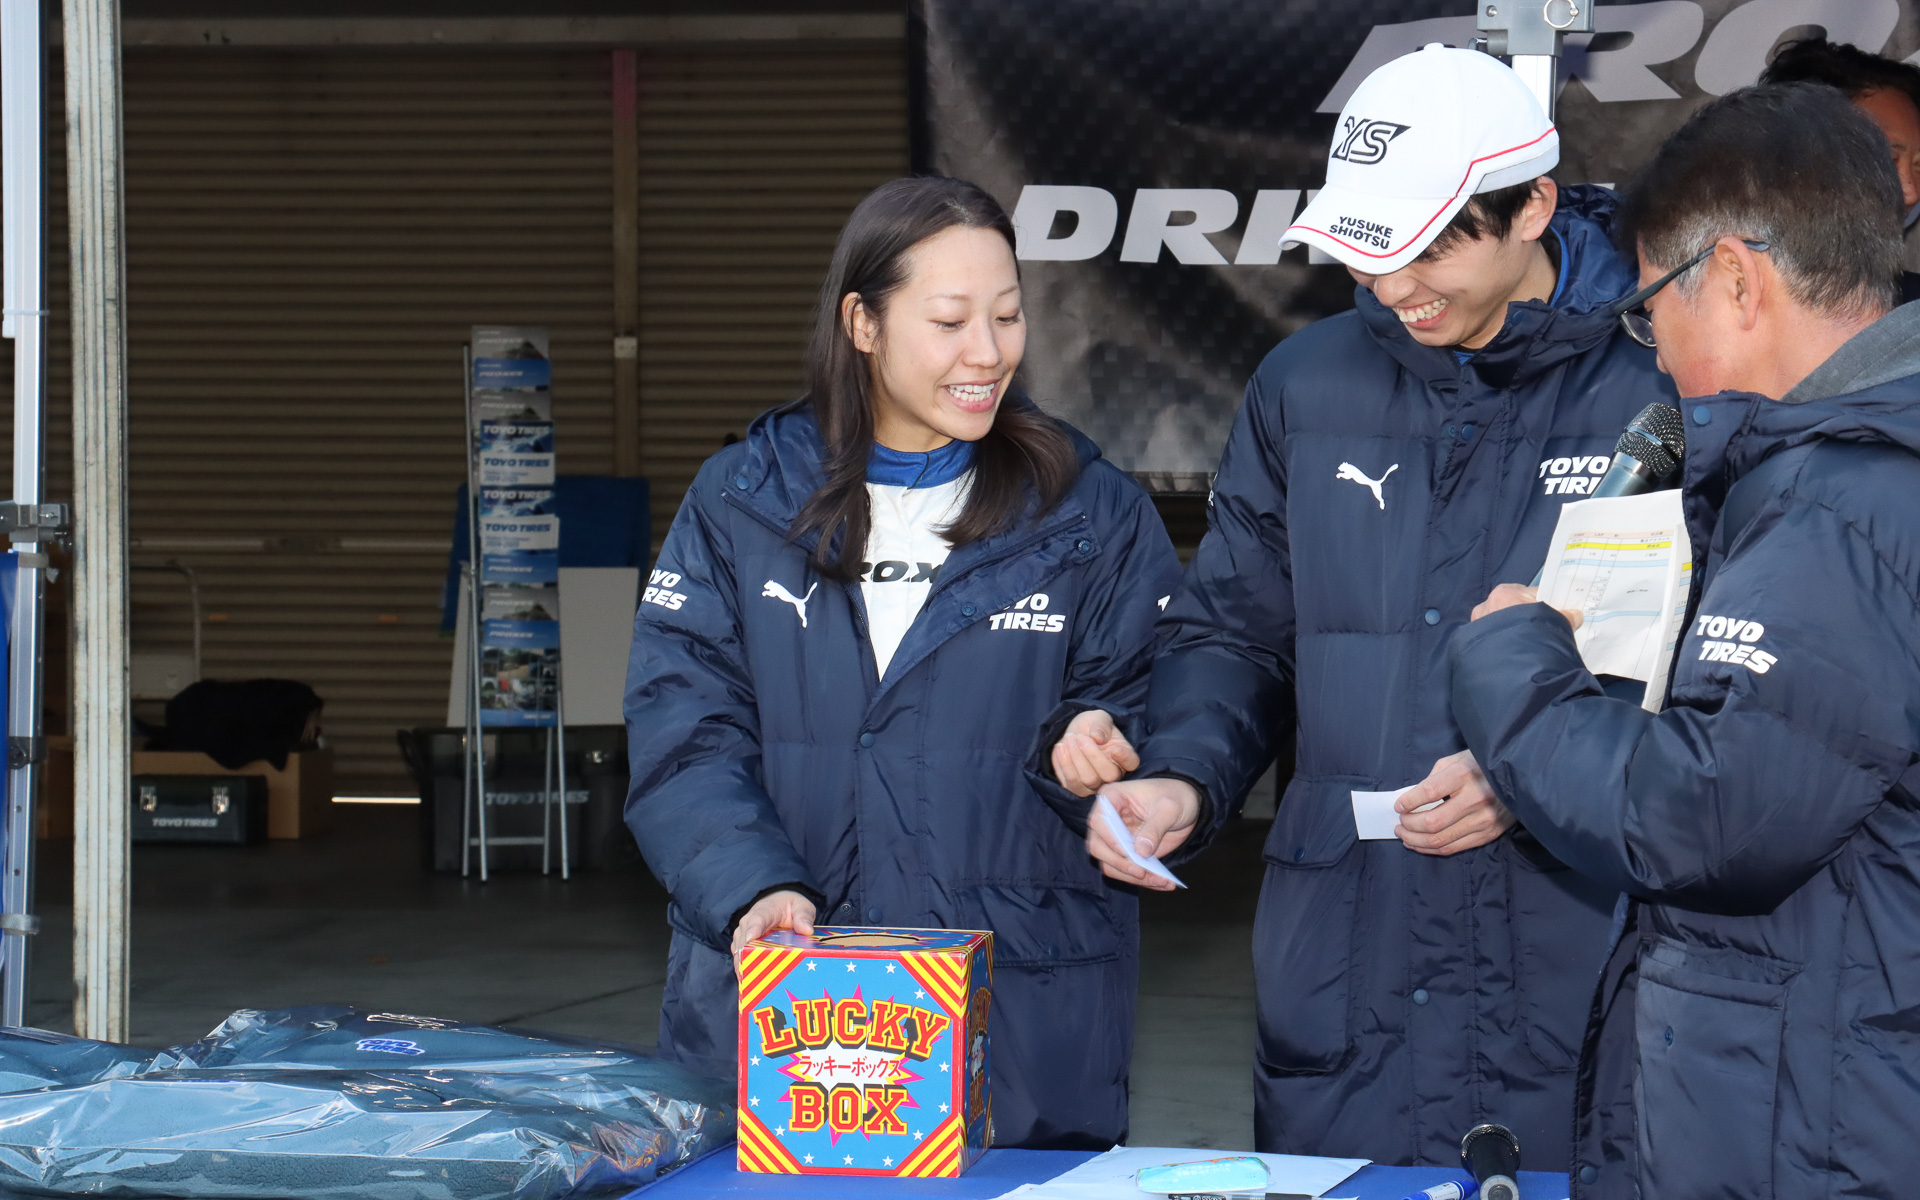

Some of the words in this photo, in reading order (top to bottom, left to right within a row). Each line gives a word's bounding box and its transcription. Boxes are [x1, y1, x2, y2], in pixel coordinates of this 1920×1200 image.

[1331, 115, 1411, 165] YS
[1329, 224, 1390, 250] SHIOTSU
[1339, 216, 1393, 238] YUSUKE
[483, 424, 516, 435] TOYO
[517, 425, 550, 435] TIRES
[483, 457, 517, 467] TOYO
[518, 458, 550, 467] TIRES
[1538, 455, 1611, 479] TOYO
[483, 490, 517, 500] TOYO
[518, 490, 551, 500] TIRES
[485, 523, 517, 533] TOYO
[519, 523, 551, 533] TIRES
[988, 611, 1066, 633] TIRES
[1696, 614, 1765, 643] TOYO
[1698, 640, 1779, 674] TIRES
[152, 817, 183, 827] TOYO
[184, 817, 219, 827] TIRES
[752, 997, 951, 1060] LUCKY
[358, 1039, 414, 1047] TOYO
[361, 1044, 422, 1055] TIRES
[798, 1055, 903, 1078] ラッキーボックス
[788, 1083, 909, 1136] BOX
